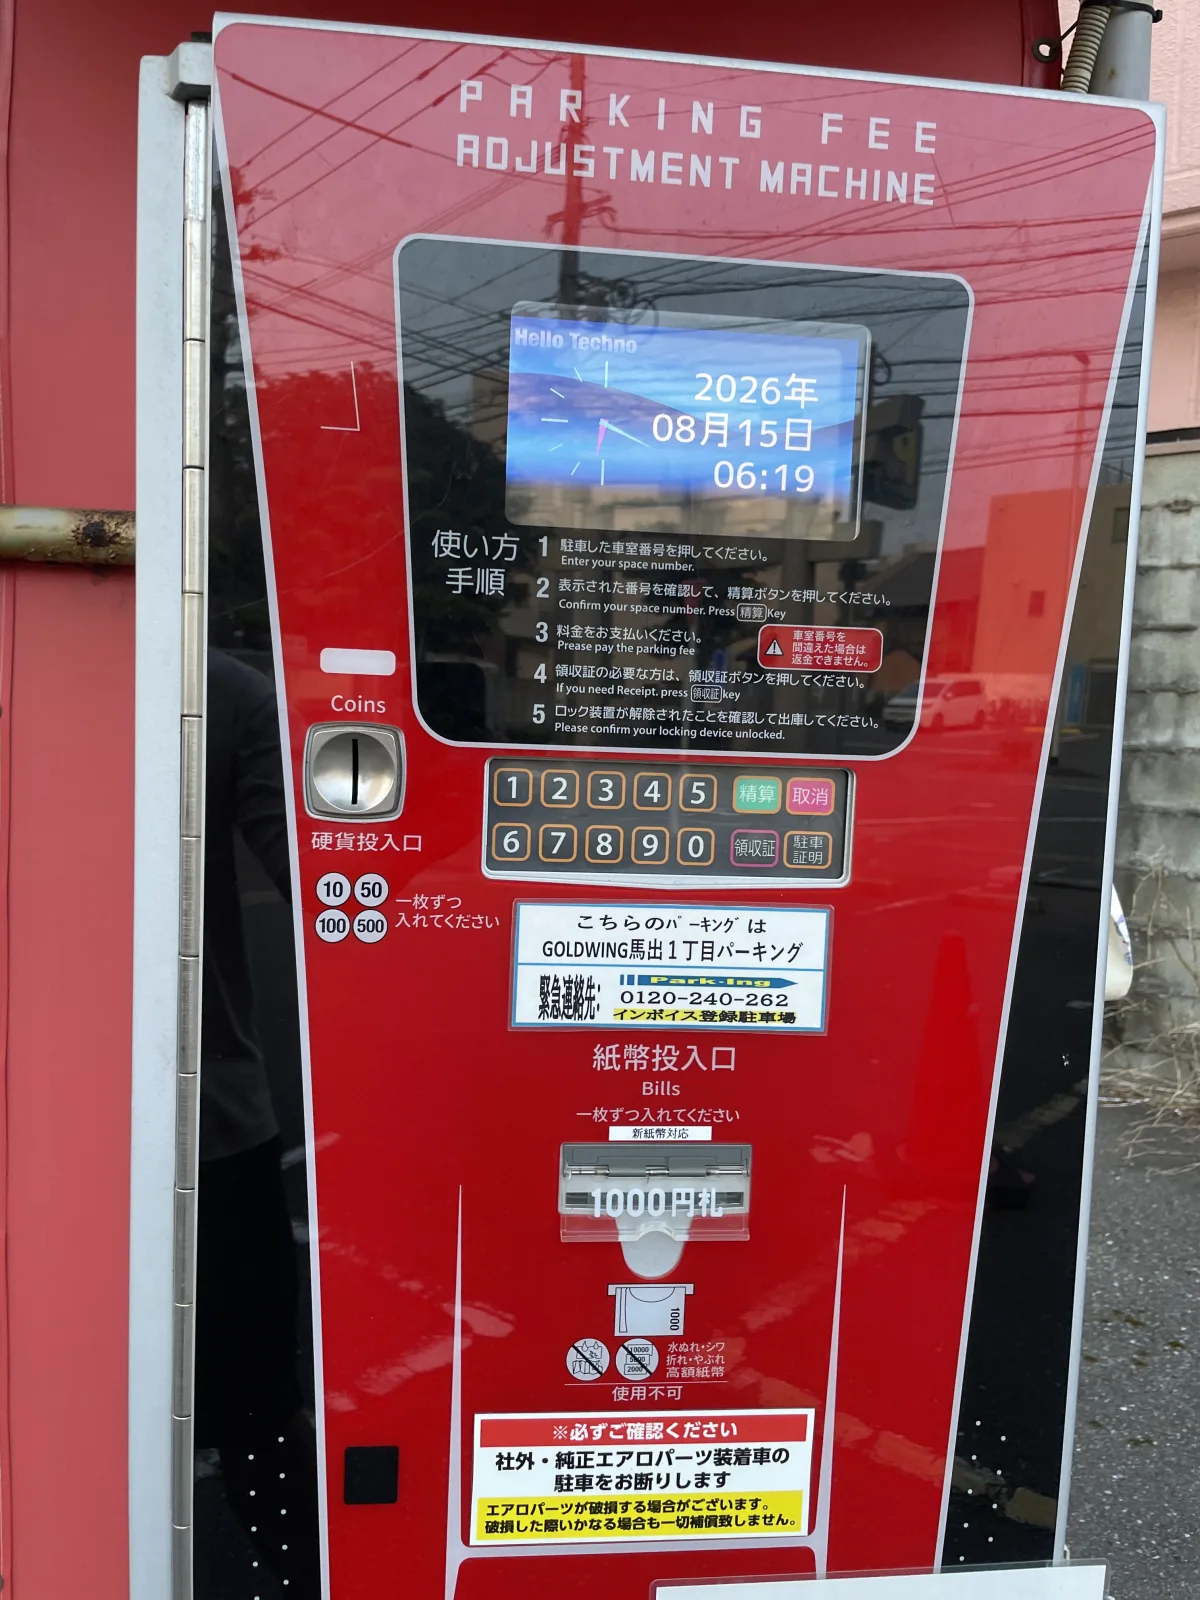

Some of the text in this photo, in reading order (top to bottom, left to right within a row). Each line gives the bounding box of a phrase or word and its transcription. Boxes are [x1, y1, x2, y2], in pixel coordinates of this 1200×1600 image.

[460, 80, 937, 154] PARKING FEE
[457, 134, 935, 206] ADJUSTMENT MACHINE
[514, 328, 637, 354] Hello Techno
[694, 373, 818, 410] 2026年
[652, 412, 812, 452] 08月15日
[713, 460, 815, 492] 06:19
[431, 529, 520, 562] 使い方
[539, 536, 768, 562] 1 駐車した車室番号を押してください。
[561, 556, 695, 572] Enter your space number.
[445, 567, 506, 597] 手順
[536, 577, 550, 598] 2
[558, 599, 786, 620] Confirm your space number. Press 精算 Key
[535, 622, 702, 644] 3 料金をお支払いください。
[793, 630, 846, 642] 車室番号を
[557, 640, 696, 657] Prease pay the parking fee
[792, 642, 866, 655] 間違えた場合は
[791, 653, 868, 667] 返金できません。
[534, 663, 547, 684] 4
[556, 683, 741, 702] If you need Receipt. press 領収証 key
[331, 694, 386, 714] Coins
[532, 704, 879, 729] 5 ロック装置が解除されたことを確認して出庫してください。
[555, 722, 786, 740] Please confirm your locking device unlocked.
[507, 776, 517, 799] 1
[552, 777, 568, 800] 2
[598, 778, 614, 802] 3
[643, 780, 662, 803] 4
[690, 781, 706, 805] 5
[738, 783, 777, 805] 精算
[792, 787, 829, 807] 取消
[311, 831, 422, 852] 硬貨投入口
[503, 830, 520, 854] 6
[550, 831, 567, 855] 7
[596, 833, 613, 856] 8
[642, 834, 660, 858] 9
[687, 834, 705, 859] 0
[734, 838, 776, 859] 領収証
[793, 835, 824, 851] 駐車
[792, 850, 824, 866] 証明
[323, 881, 344, 898] 10
[360, 881, 383, 899] 50
[395, 893, 462, 910] 一枚ずつ
[319, 917, 347, 934] 100
[357, 918, 385, 935] 500
[395, 912, 500, 930] 入れてください
[620, 990, 789, 1007] 0120-240-262
[613, 1008, 797, 1024] インボイス登録駐車場
[592, 1043, 736, 1072] 紙幣投入口
[641, 1081, 681, 1097] Bills
[576, 1107, 741, 1124] 一枚ずつ入れてください
[632, 1127, 689, 1140] 新紙幣対応
[590, 1187, 724, 1219] 1000円札
[669, 1307, 680, 1331] 1000
[668, 1341, 726, 1353] 水ぬれ・シワ
[666, 1354, 726, 1366] 折れ・やぶれ
[666, 1366, 725, 1379] 高額紙幣
[611, 1385, 684, 1402] 使用不可
[495, 1447, 790, 1471] 社外・純正エアロパーツ装着車の
[553, 1471, 731, 1493] 駐車をお断りします
[486, 1497, 769, 1517] エアロパーツが破損する場合がございます。
[484, 1512, 796, 1535] 破損した際いかなる場合も一切補償致しません。
